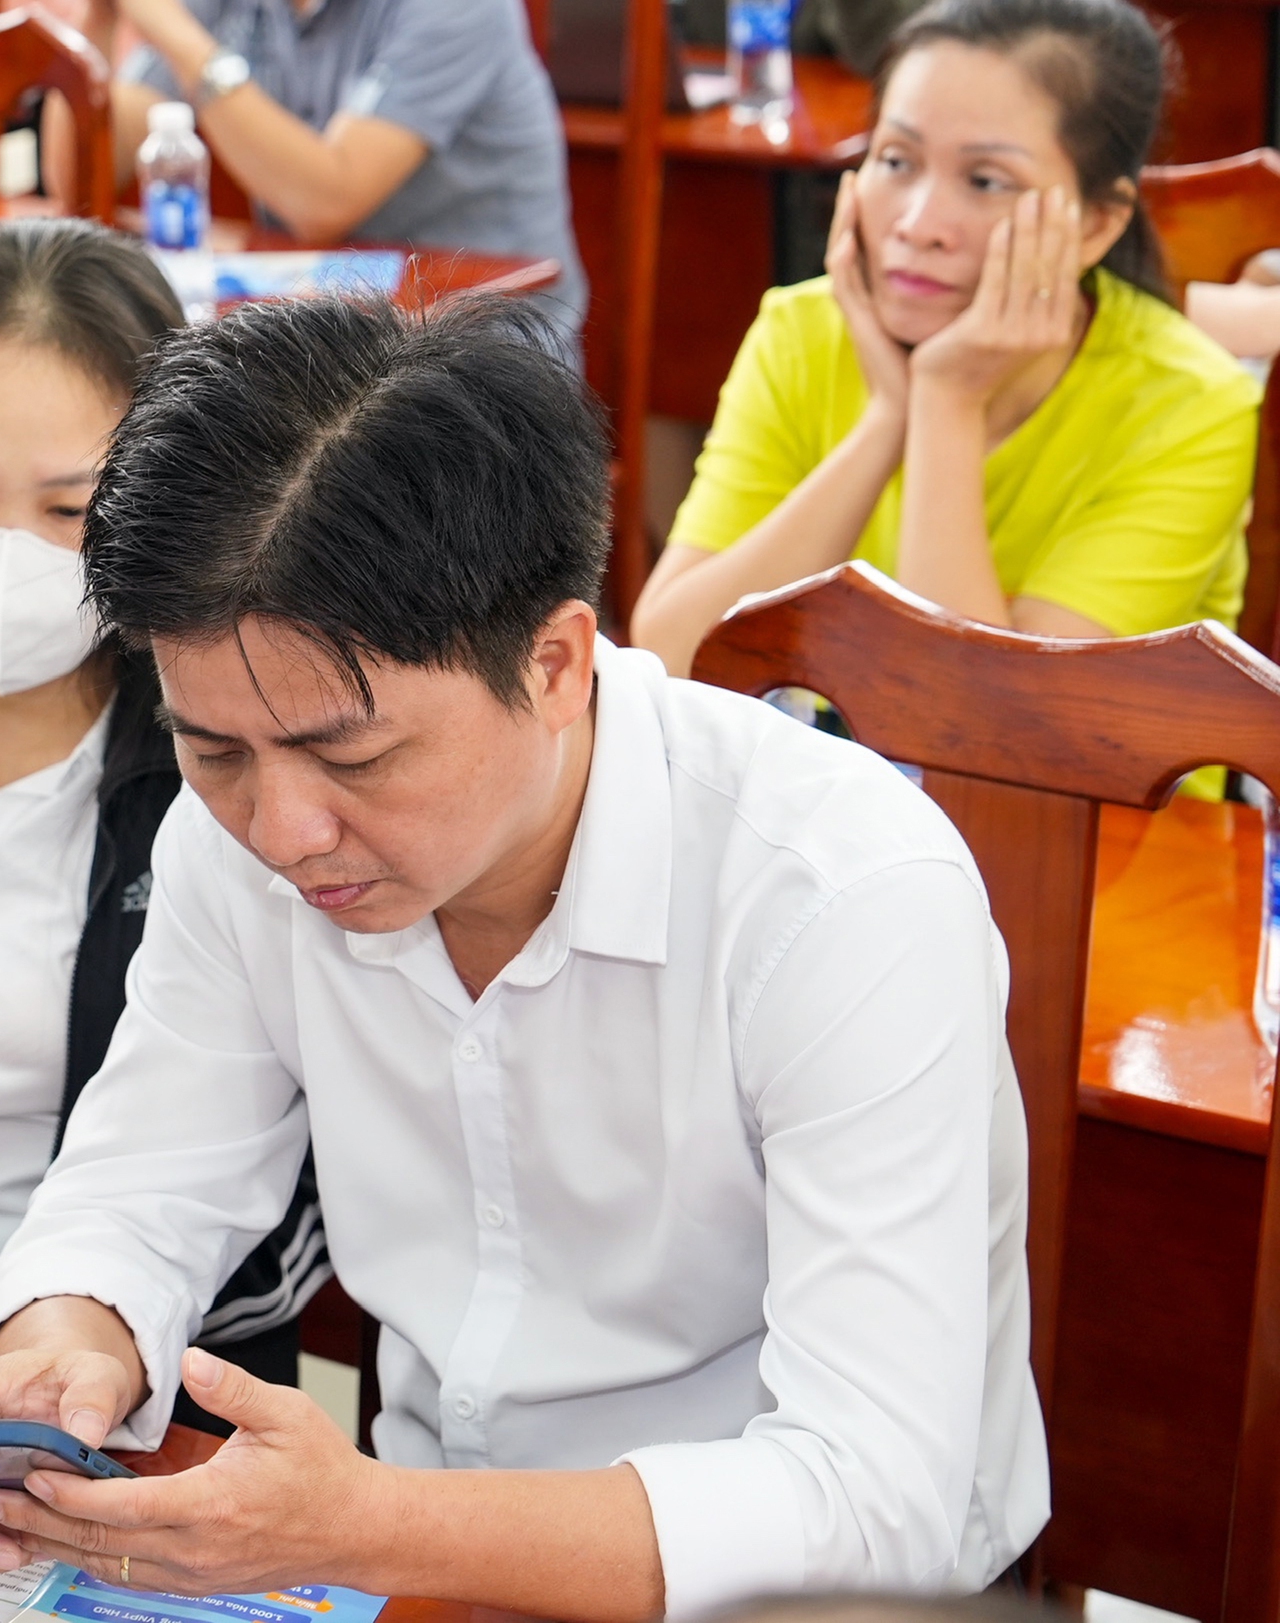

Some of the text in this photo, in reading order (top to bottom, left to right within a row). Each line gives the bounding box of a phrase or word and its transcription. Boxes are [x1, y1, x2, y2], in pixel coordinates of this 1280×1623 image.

[93, 1606, 121, 1617] HKD
[226, 1602, 249, 1613] Hóa
[122, 1612, 156, 1623] VNPT
[249, 1608, 284, 1622] 1.000
